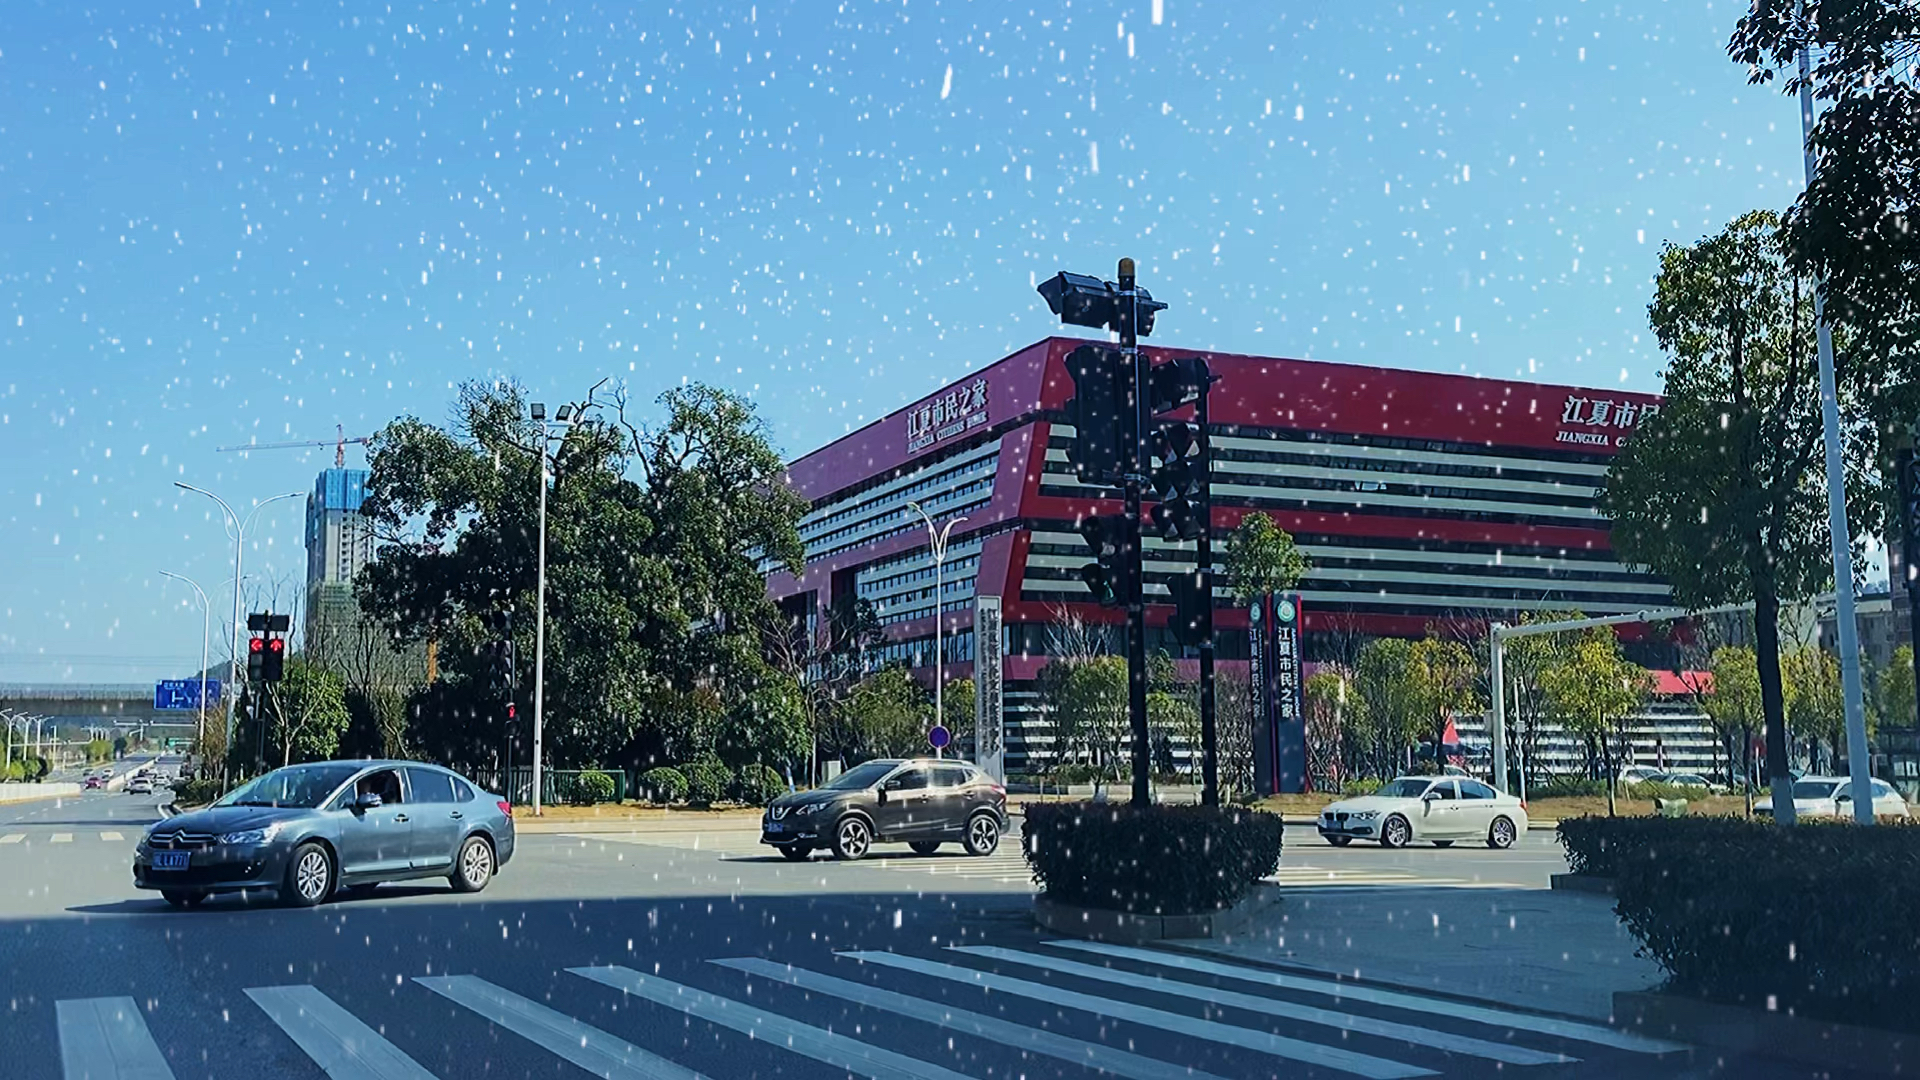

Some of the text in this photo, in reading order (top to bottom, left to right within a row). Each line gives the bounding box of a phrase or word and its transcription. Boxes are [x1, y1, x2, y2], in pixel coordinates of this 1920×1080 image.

[907, 378, 988, 439] 江夏市民之家
[1556, 430, 1609, 446] JIANGXIA
[1249, 628, 1261, 718] 江夏市民之家
[1278, 626, 1294, 719] 江夏市民之家
